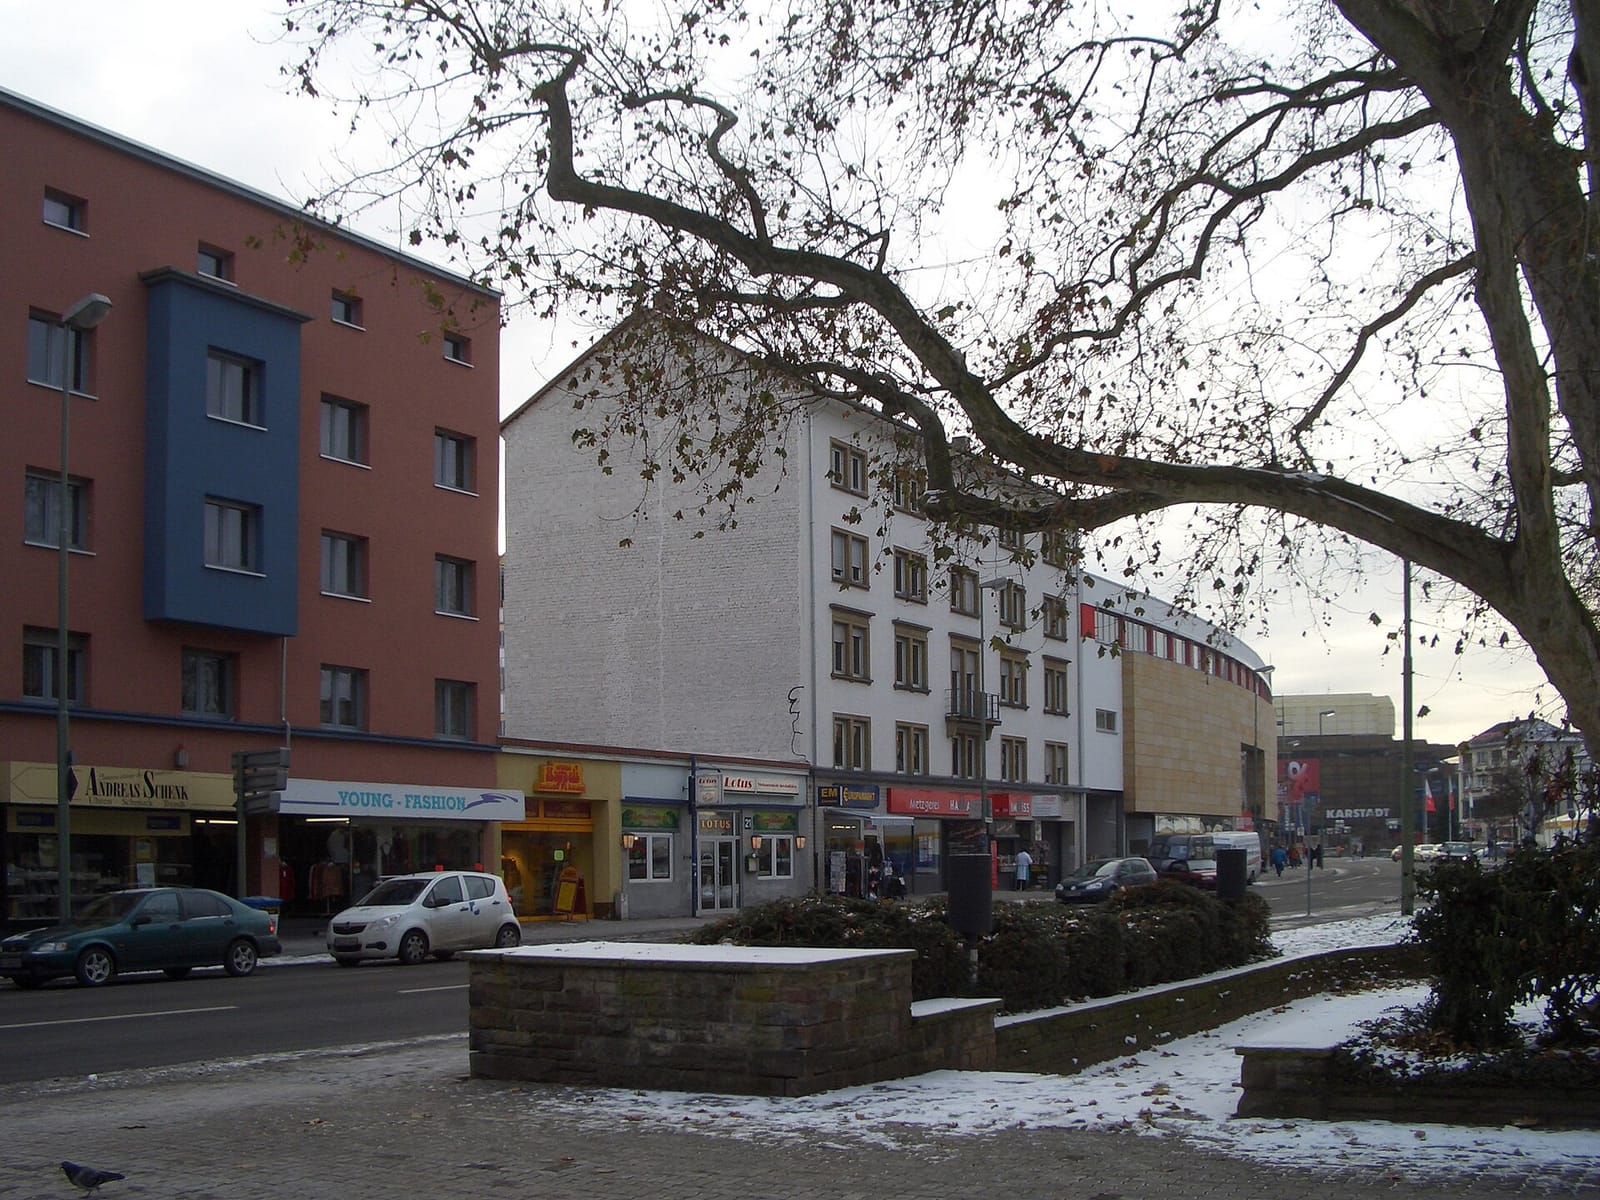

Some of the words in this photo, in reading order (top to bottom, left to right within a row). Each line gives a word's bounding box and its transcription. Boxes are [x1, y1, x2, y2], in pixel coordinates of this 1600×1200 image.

[85, 767, 141, 798] ANDREAS
[143, 770, 189, 800] SCHENK
[723, 776, 753, 789] Lotus
[820, 788, 838, 798] EM
[337, 791, 394, 807] YOUNG
[405, 793, 466, 810] FASHION
[1326, 808, 1391, 818] KARSTADT
[701, 819, 731, 829] LOTUS
